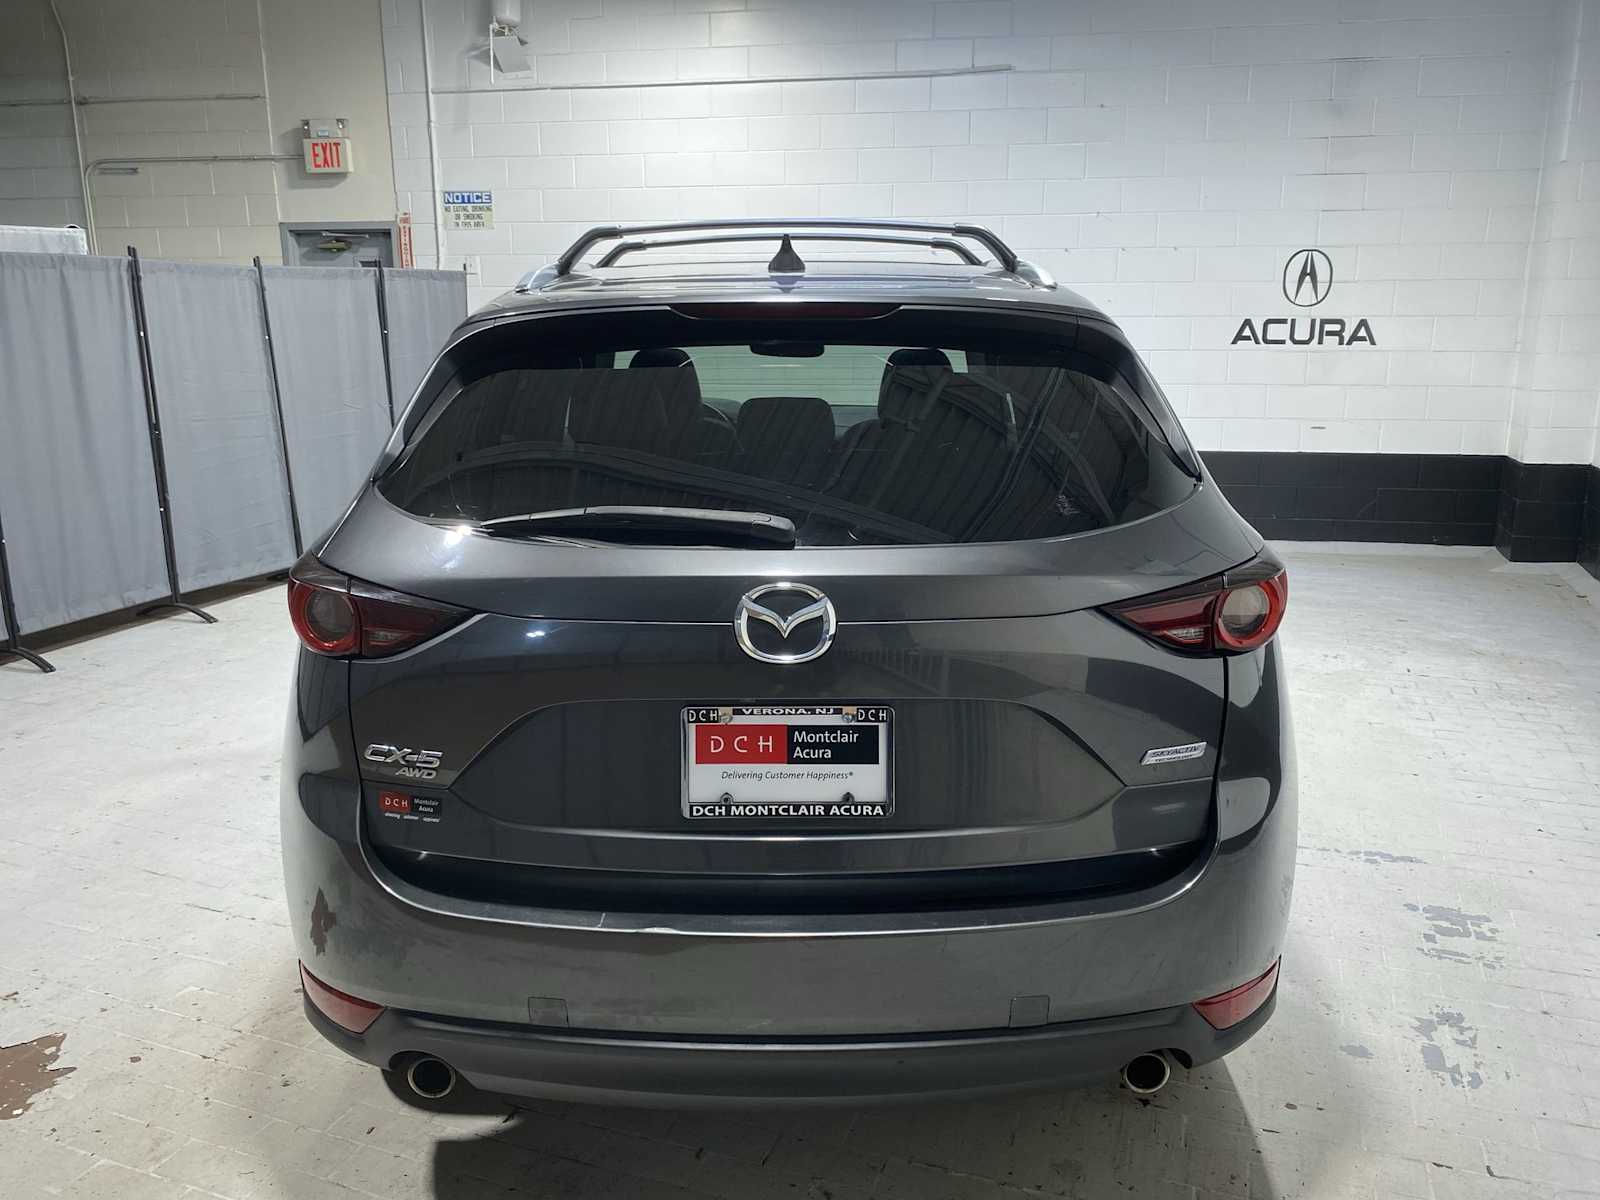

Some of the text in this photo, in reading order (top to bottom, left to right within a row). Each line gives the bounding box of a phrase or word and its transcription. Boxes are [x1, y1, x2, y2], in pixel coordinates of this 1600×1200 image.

[312, 142, 341, 168] EXIT
[445, 192, 491, 203] NOTICE
[1230, 318, 1377, 346] ACURA
[793, 730, 859, 743] Montclair
[364, 744, 443, 768] CX-5
[793, 746, 832, 759] Acura
[395, 767, 437, 779] AWD
[721, 770, 763, 781] Delivering
[765, 770, 805, 779] Customer
[692, 805, 884, 816] DCH MONTCLAIR ACURA
